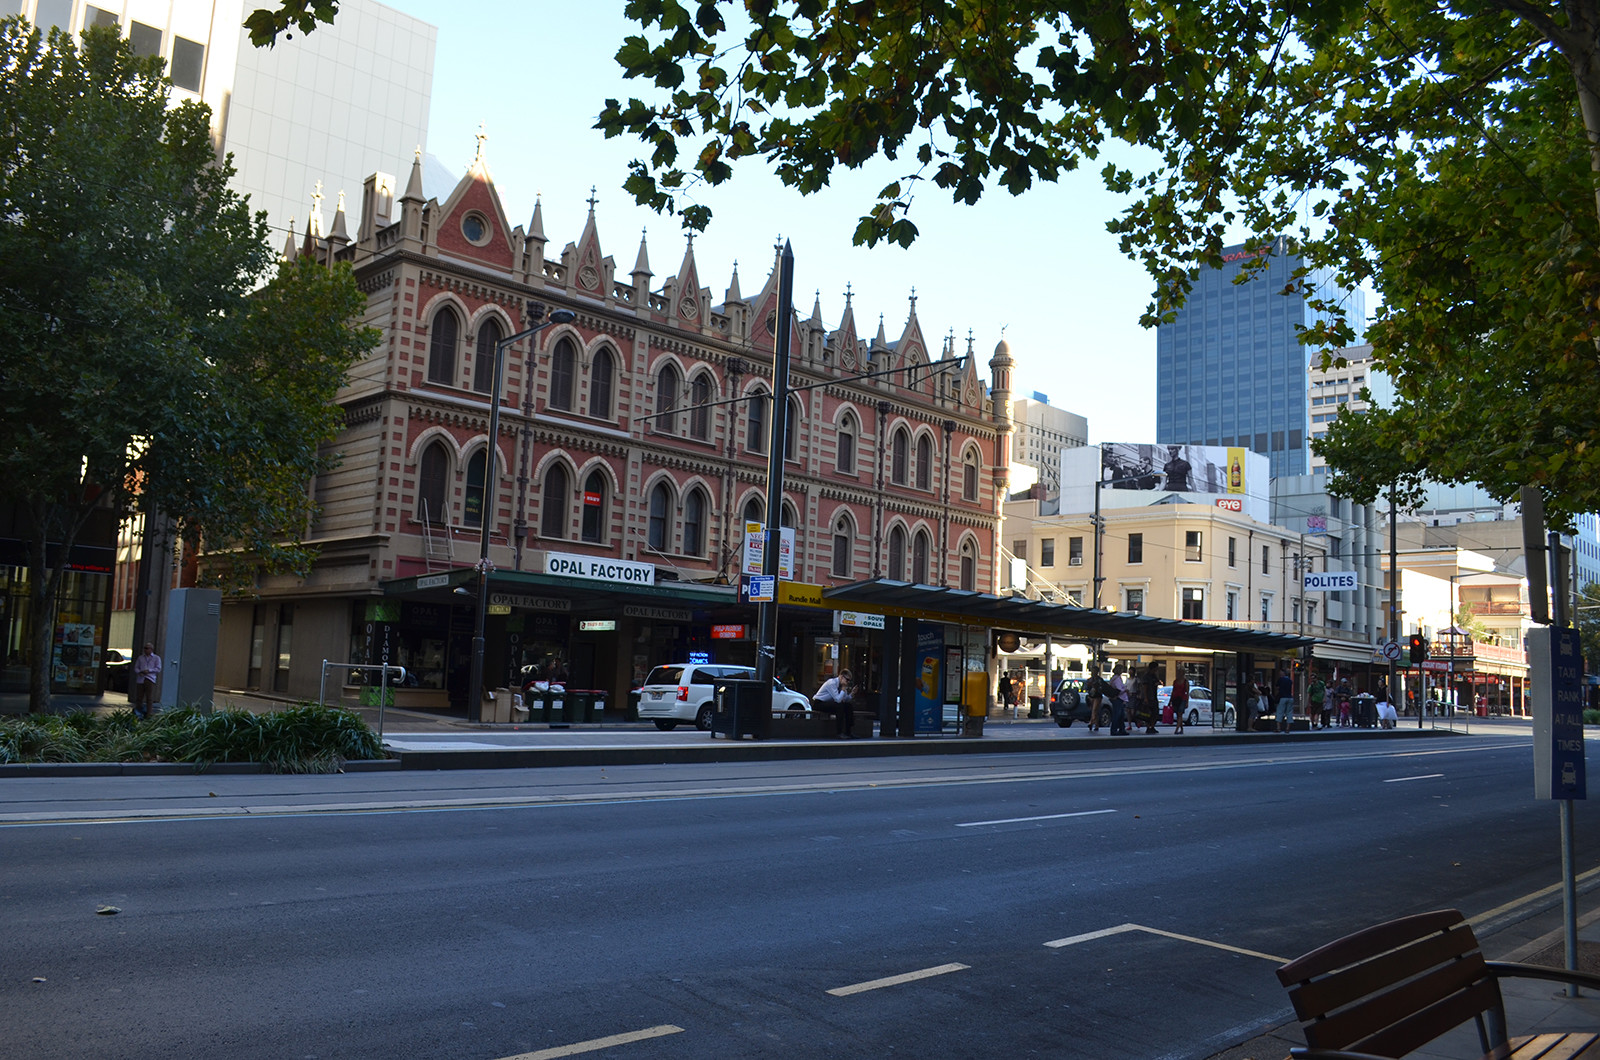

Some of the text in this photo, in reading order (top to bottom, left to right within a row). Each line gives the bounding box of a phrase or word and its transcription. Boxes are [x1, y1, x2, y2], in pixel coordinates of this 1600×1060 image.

[1218, 500, 1240, 509] eye
[550, 559, 650, 581] OPAL FACTORY
[1304, 575, 1353, 587] POLITES
[493, 593, 569, 609] OPAL FACTORY
[788, 594, 821, 605] Rundle Mall
[625, 606, 690, 619] OPAL FACTORY
[1557, 666, 1576, 679] TAXI
[1557, 690, 1579, 702] RANK
[1555, 713, 1582, 726] AT ALL
[1557, 739, 1582, 751] TIMES
